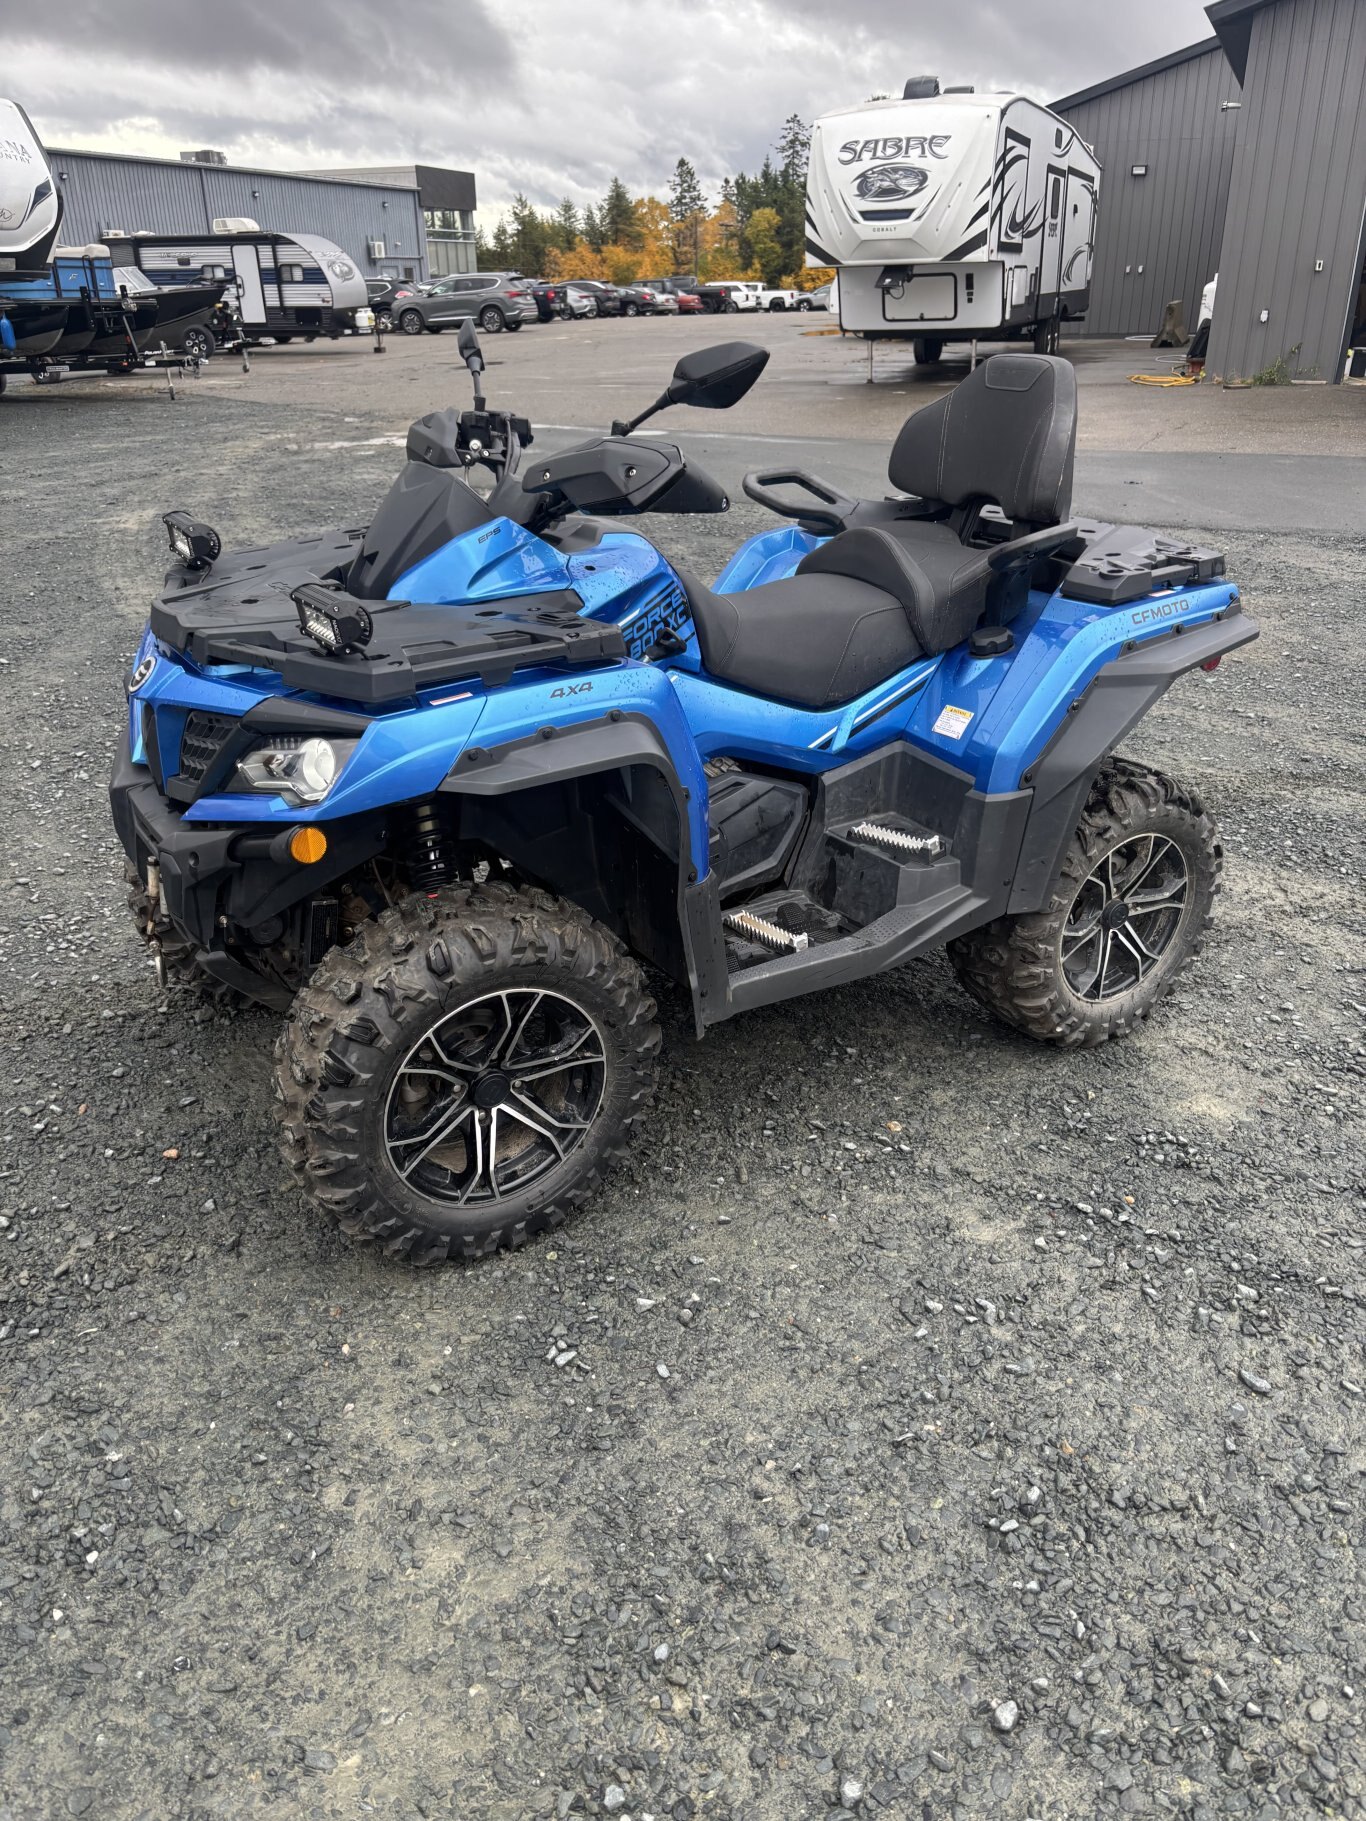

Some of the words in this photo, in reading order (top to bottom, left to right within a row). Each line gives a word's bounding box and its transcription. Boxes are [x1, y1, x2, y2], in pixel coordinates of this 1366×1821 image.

[838, 135, 952, 165] SABRE
[478, 526, 502, 544] EPS
[622, 588, 683, 642] FORCE
[667, 604, 687, 630] XC
[1131, 599, 1189, 625] CFMOTO
